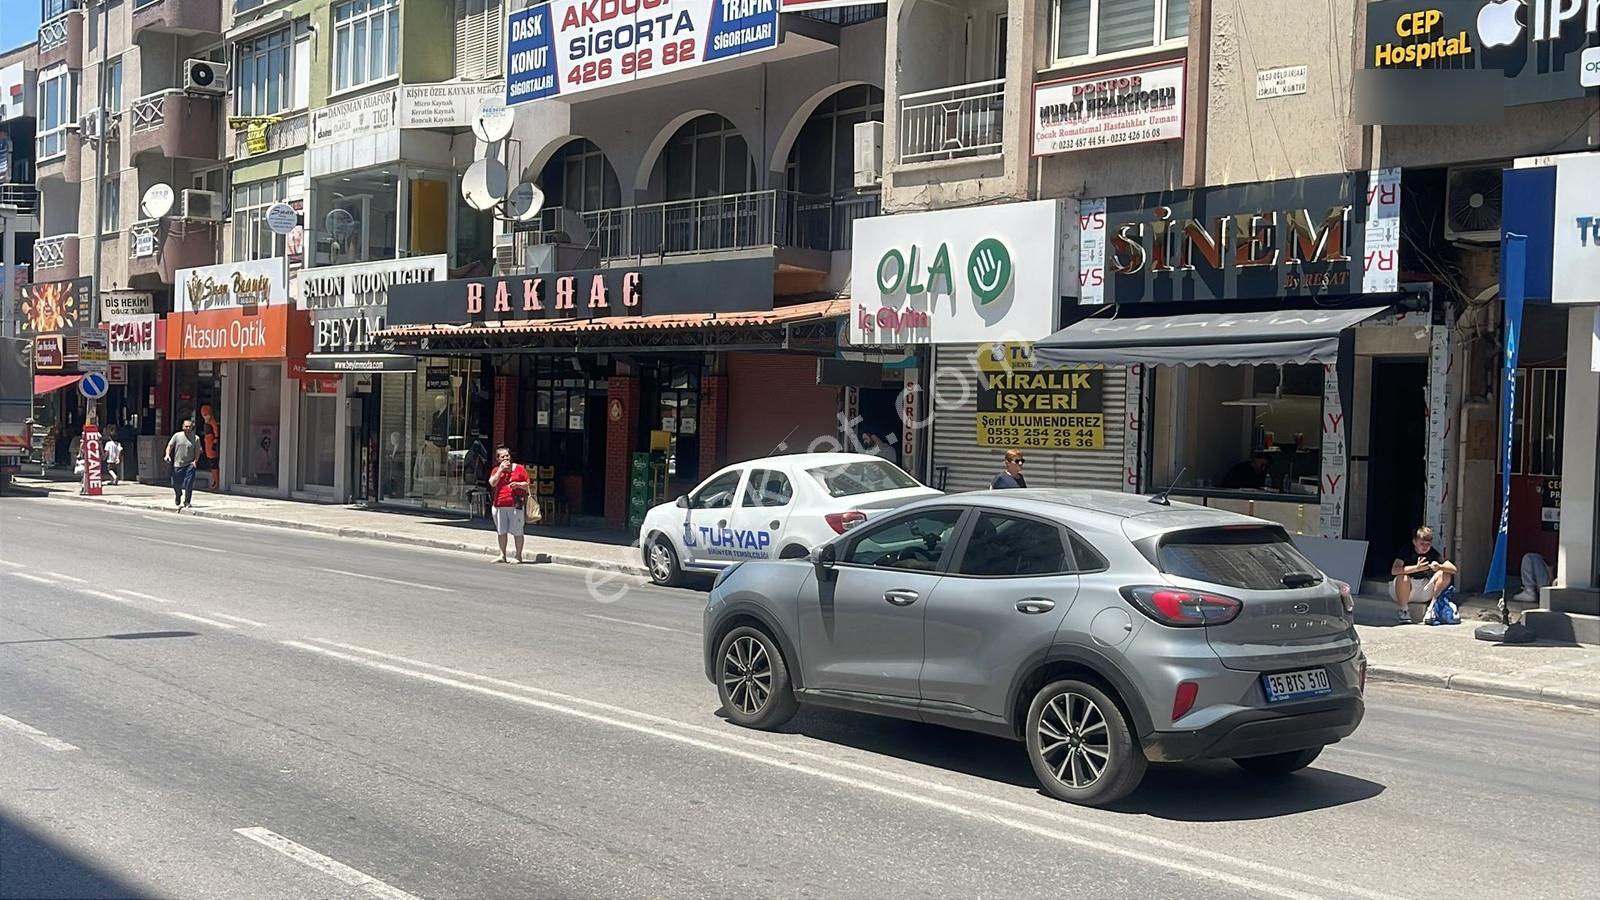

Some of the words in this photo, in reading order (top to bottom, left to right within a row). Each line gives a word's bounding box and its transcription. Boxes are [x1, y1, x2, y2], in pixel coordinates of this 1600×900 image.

[512, 14, 542, 42] DASK
[569, 9, 694, 60] SİGORTA
[713, 22, 772, 50] SİGORTALARI
[1396, 9, 1440, 37] CEP
[511, 46, 548, 75] KONUT
[567, 58, 613, 85] 426
[621, 48, 653, 73] 92
[661, 38, 696, 64] 82
[510, 74, 554, 97] SİGORTALARI
[1059, 138, 1074, 149] 0232
[1088, 136, 1097, 146] 44
[1111, 133, 1127, 143] 0232
[1142, 129, 1151, 139] 16
[1110, 204, 1352, 275] SİNEM
[876, 242, 953, 295] OLA
[303, 277, 344, 297] SALON
[184, 323, 227, 349] Atasun
[231, 319, 267, 353] Optik
[996, 390, 1078, 413] İŞYERİ
[982, 415, 1007, 428] Şerif
[1010, 416, 1101, 428] ULUMENDEREZ
[988, 428, 1019, 436] 0553
[1024, 428, 1049, 437] 254
[1054, 429, 1071, 437] 26
[1075, 429, 1094, 438] 44
[988, 437, 1019, 445] 0232
[1024, 437, 1049, 445] 487
[1054, 438, 1071, 446] 36
[1076, 439, 1094, 447] 36
[86, 431, 102, 489] ECZANE
[699, 526, 770, 550] TURYAP
[1271, 677, 1285, 694] 35
[1286, 674, 1306, 692] BTS
[1307, 671, 1328, 689] 510
